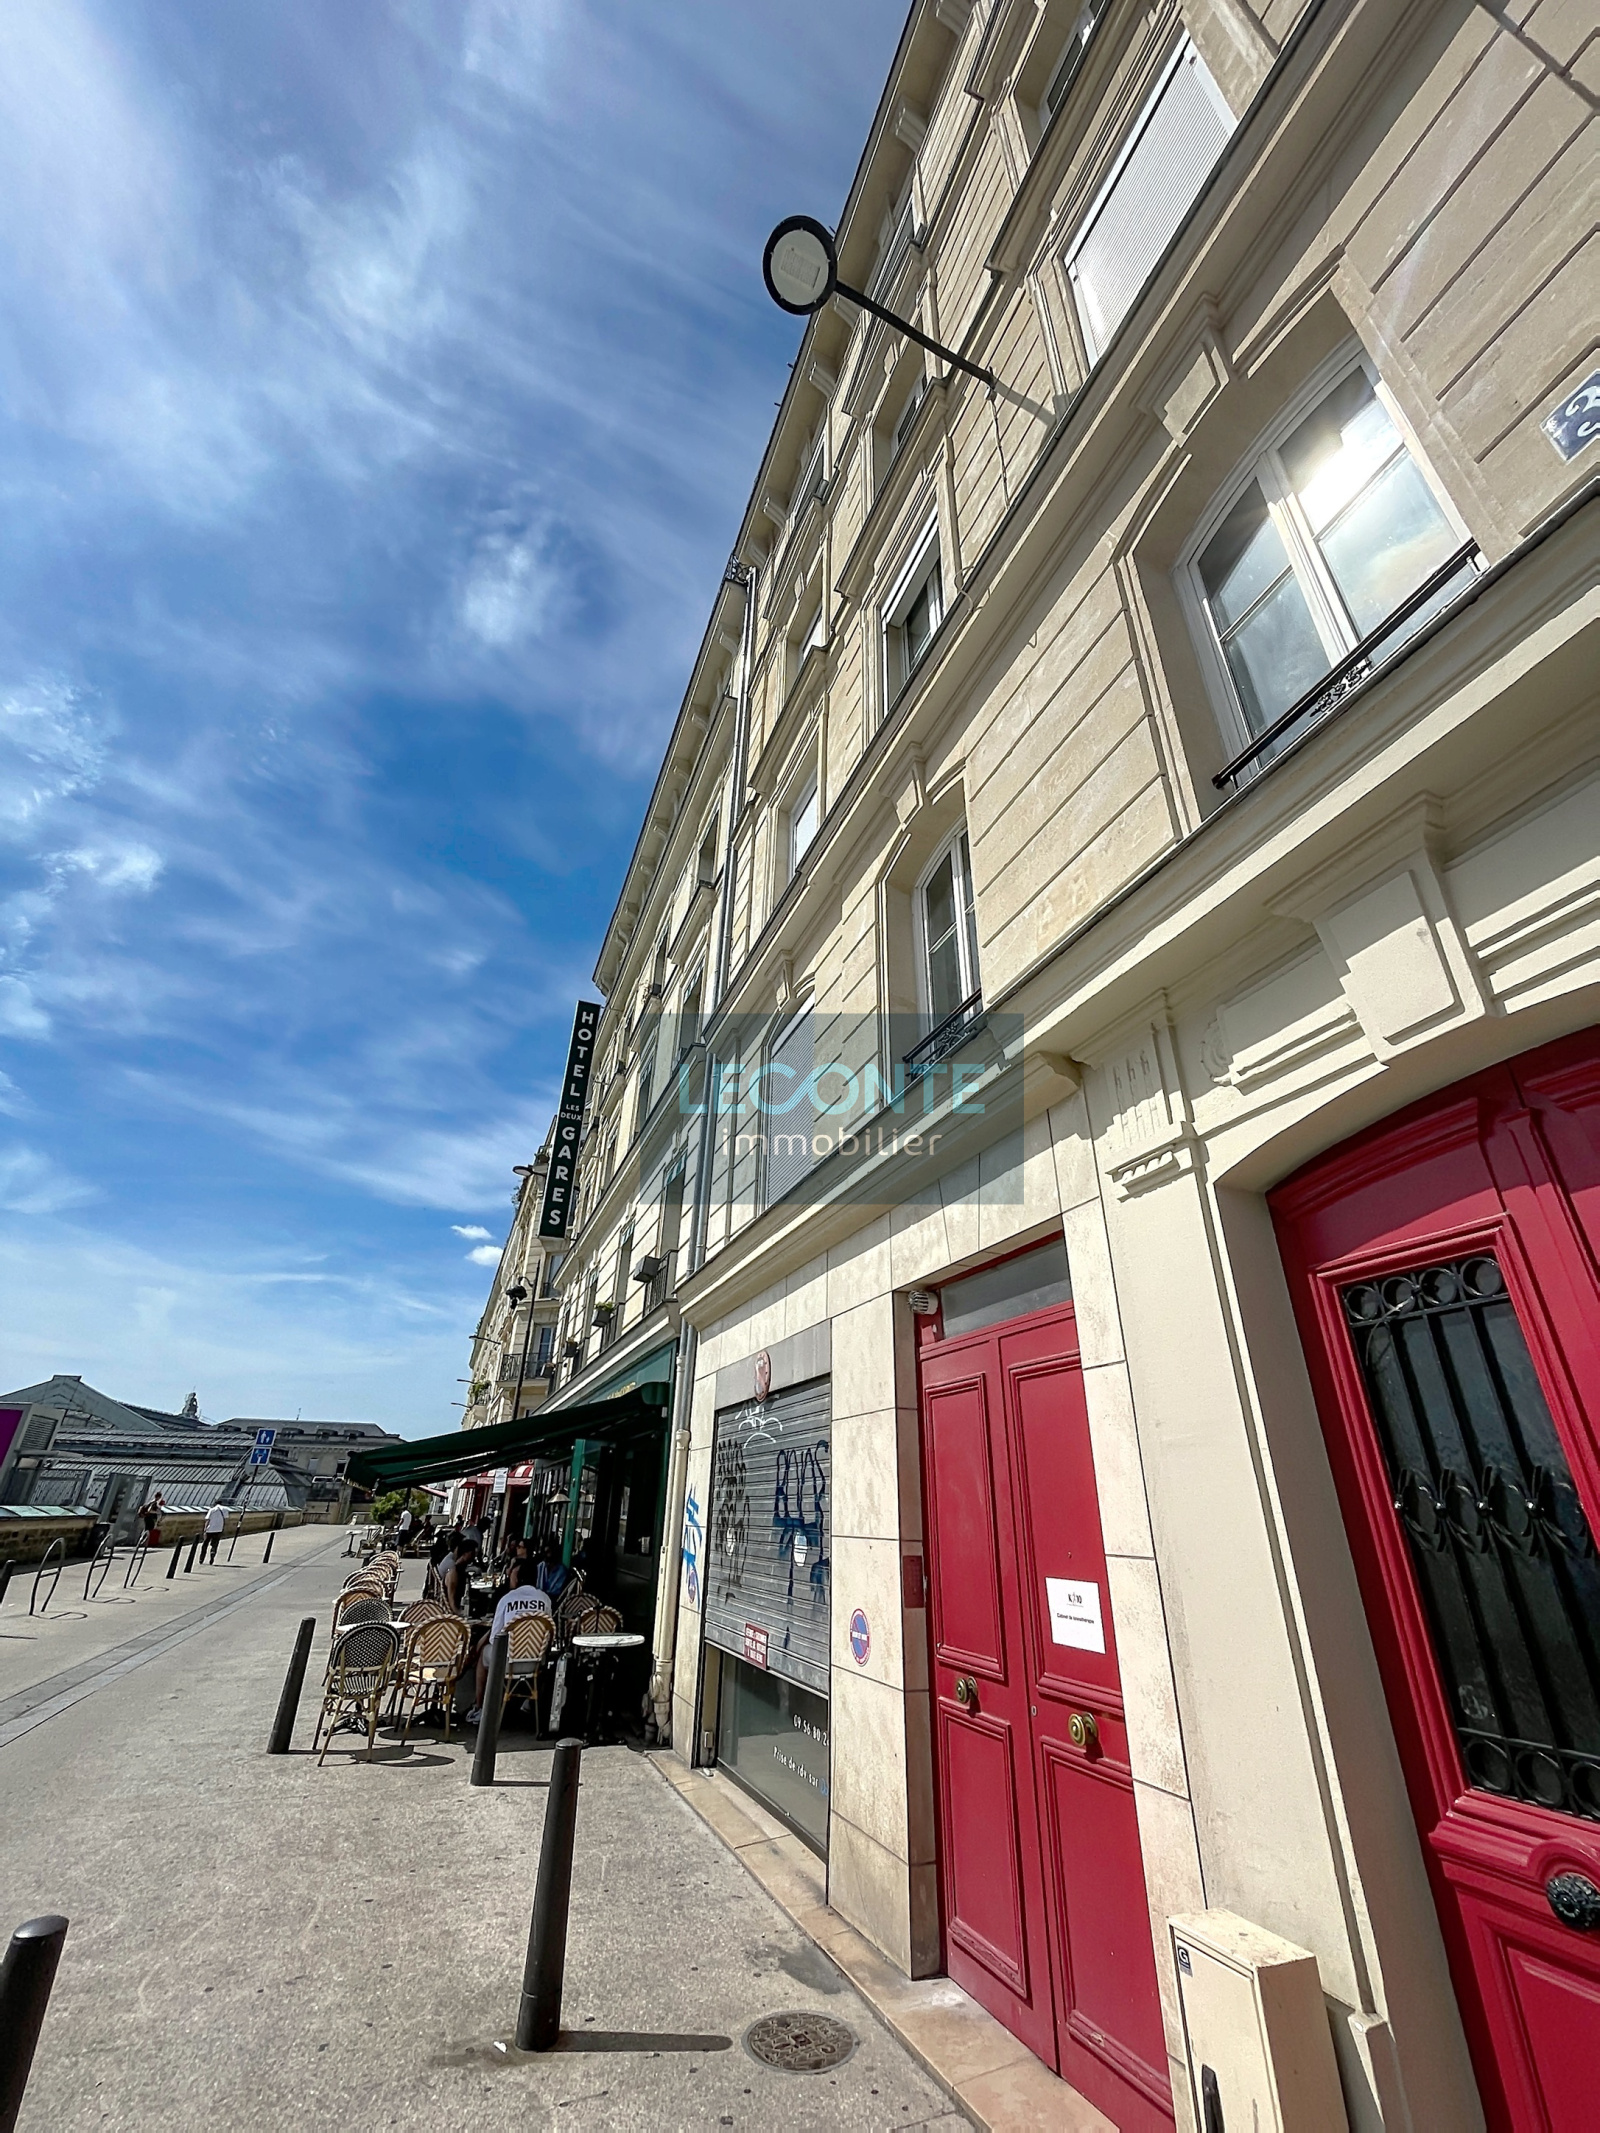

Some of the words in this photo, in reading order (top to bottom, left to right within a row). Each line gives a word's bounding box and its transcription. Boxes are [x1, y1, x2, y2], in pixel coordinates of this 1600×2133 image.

[569, 1010, 594, 1097] HOTEL
[560, 1111, 582, 1121] DEUX
[565, 1103, 580, 1112] LES
[548, 1126, 575, 1226] GARES
[507, 1600, 545, 1612] MNSR
[803, 1719, 811, 1736] 56
[773, 1746, 787, 1766] Prise
[788, 1756, 796, 1772] de
